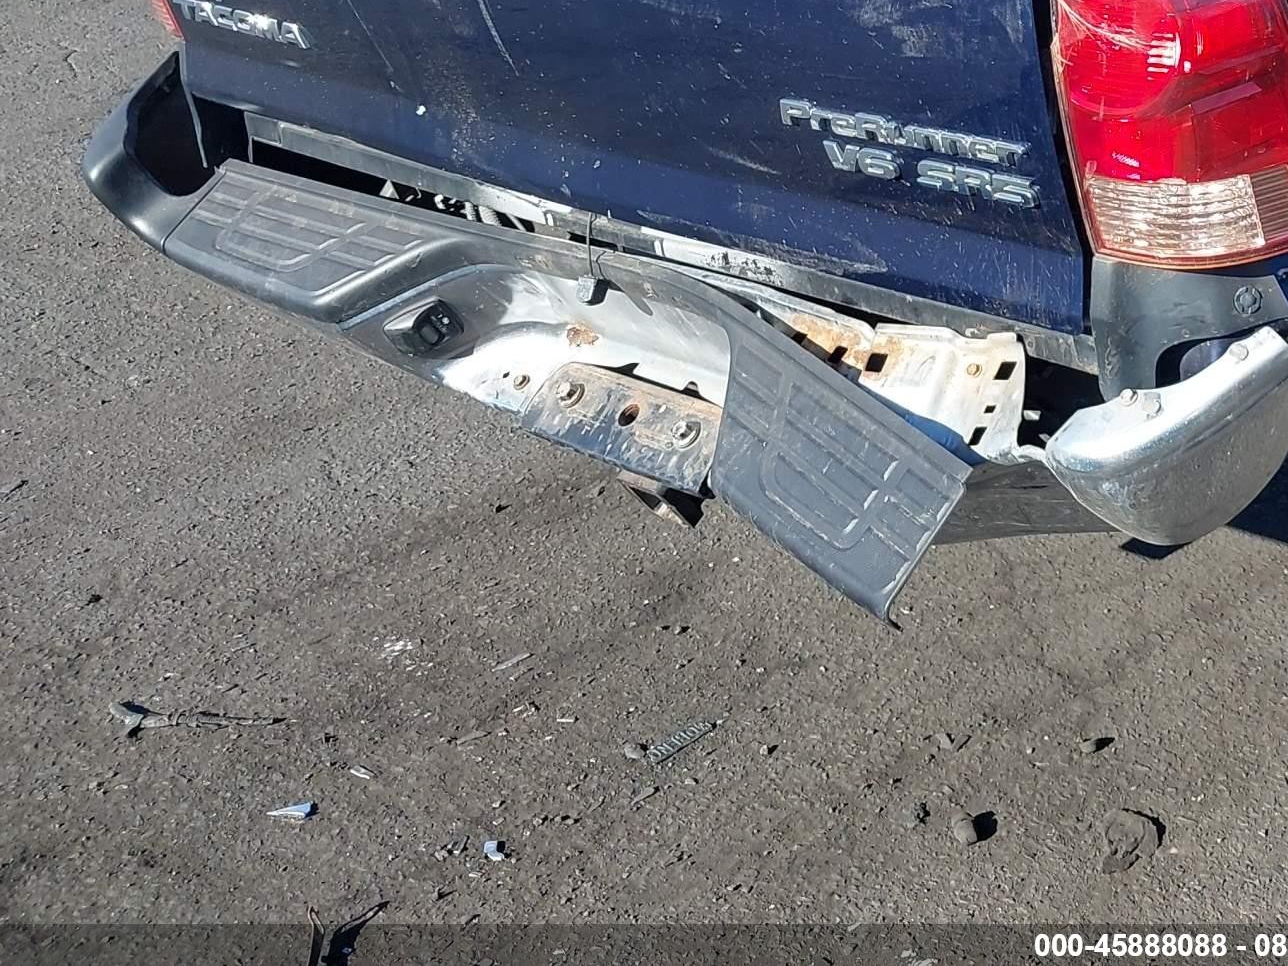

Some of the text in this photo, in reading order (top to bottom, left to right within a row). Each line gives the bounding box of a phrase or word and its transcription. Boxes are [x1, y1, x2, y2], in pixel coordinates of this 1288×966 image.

[779, 97, 1032, 167] PreRunner
[822, 138, 1040, 209] V6 SR5
